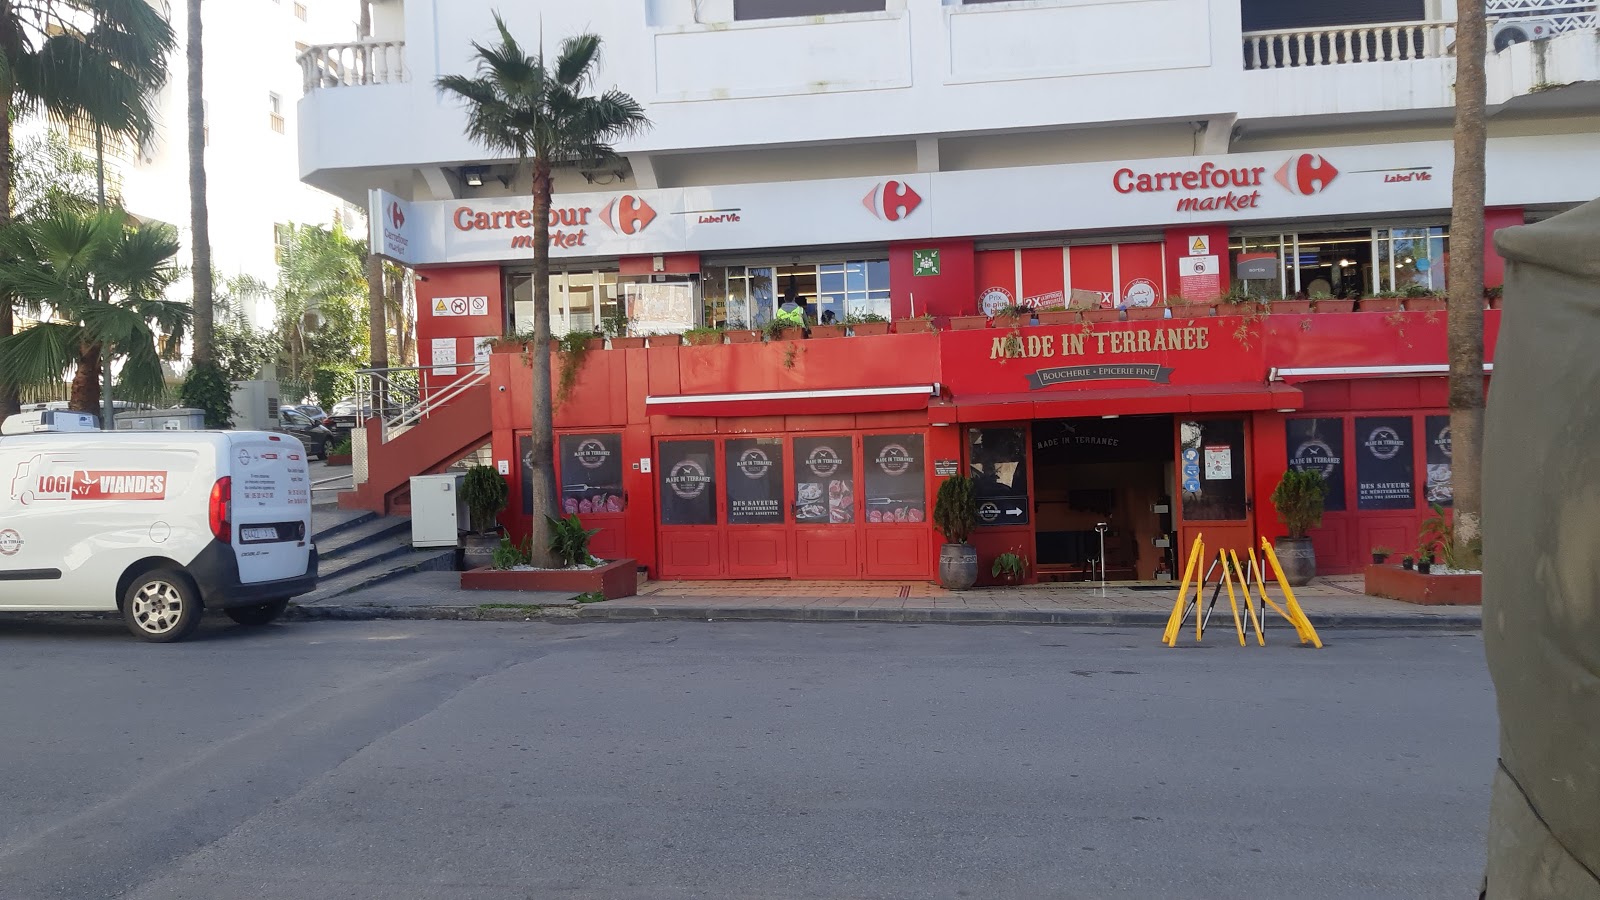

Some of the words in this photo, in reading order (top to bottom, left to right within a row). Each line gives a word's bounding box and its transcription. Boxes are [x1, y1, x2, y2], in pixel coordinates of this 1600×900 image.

[1112, 162, 1266, 194] Carrefour
[1176, 189, 1262, 212] market
[453, 206, 592, 231] Carreour
[511, 229, 586, 249] mrket
[990, 335, 1054, 359] MADE
[1061, 333, 1086, 355] IN
[1092, 320, 1209, 354] TERRANÉE
[1043, 370, 1091, 381] BOUCHERIE
[1099, 367, 1135, 375] EPICERIE
[1136, 368, 1155, 376] FINE
[1037, 438, 1058, 450] MADE
[39, 476, 71, 493] LOGI
[100, 476, 164, 494] VIANDES
